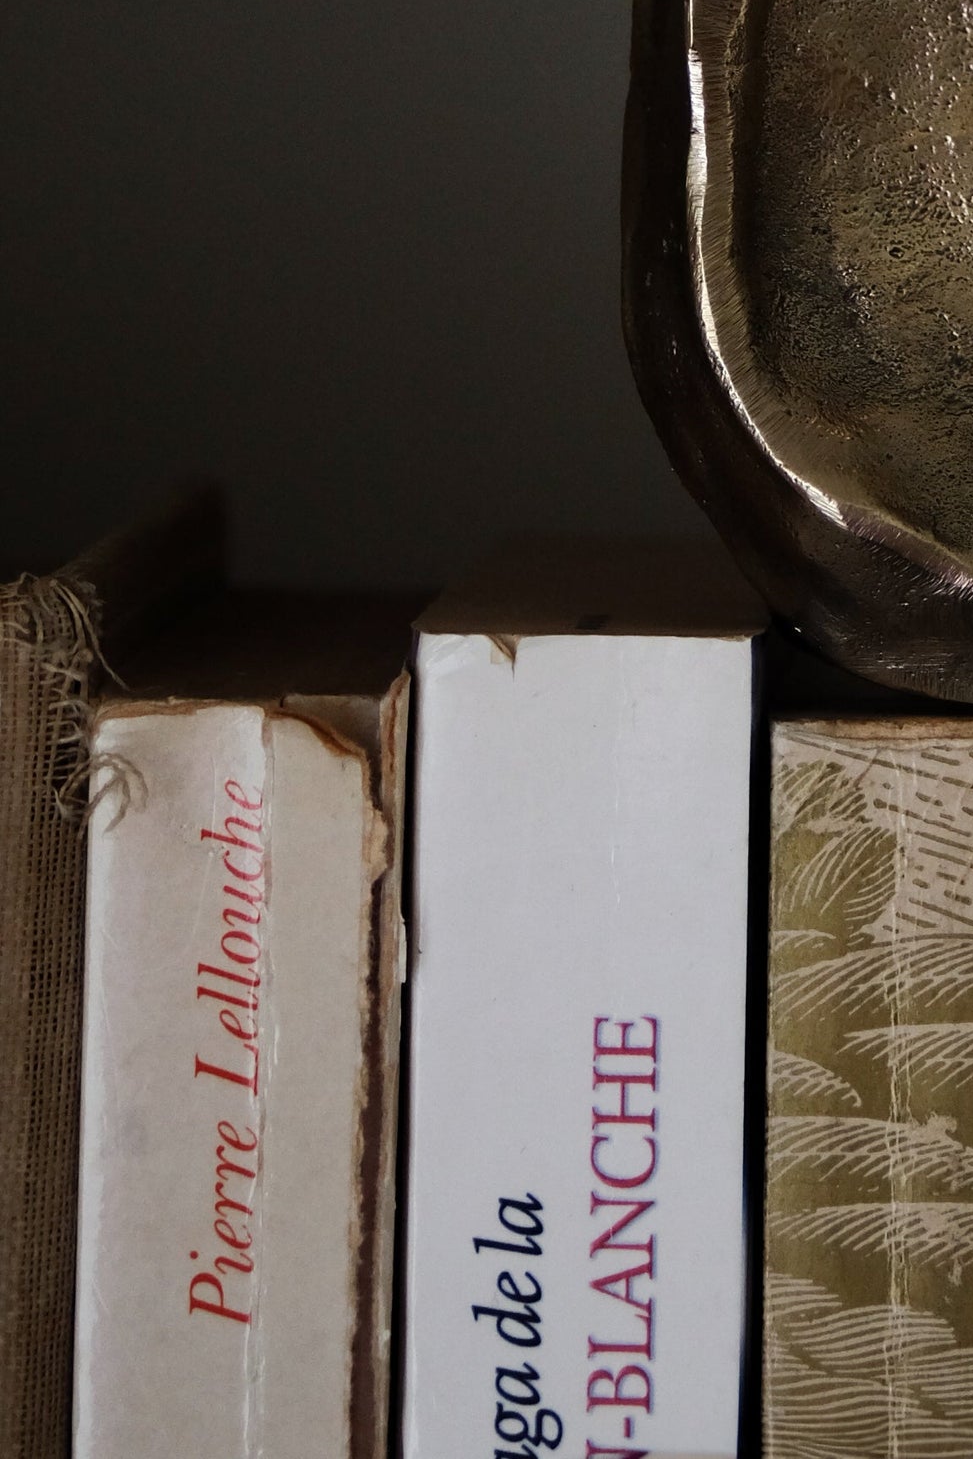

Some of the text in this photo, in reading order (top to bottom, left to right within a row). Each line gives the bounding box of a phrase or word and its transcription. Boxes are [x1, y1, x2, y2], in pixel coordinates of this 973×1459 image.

[187, 778, 264, 1327] Pierre Lellouche
[472, 1192, 545, 1257] la
[471, 1270, 544, 1349] de
